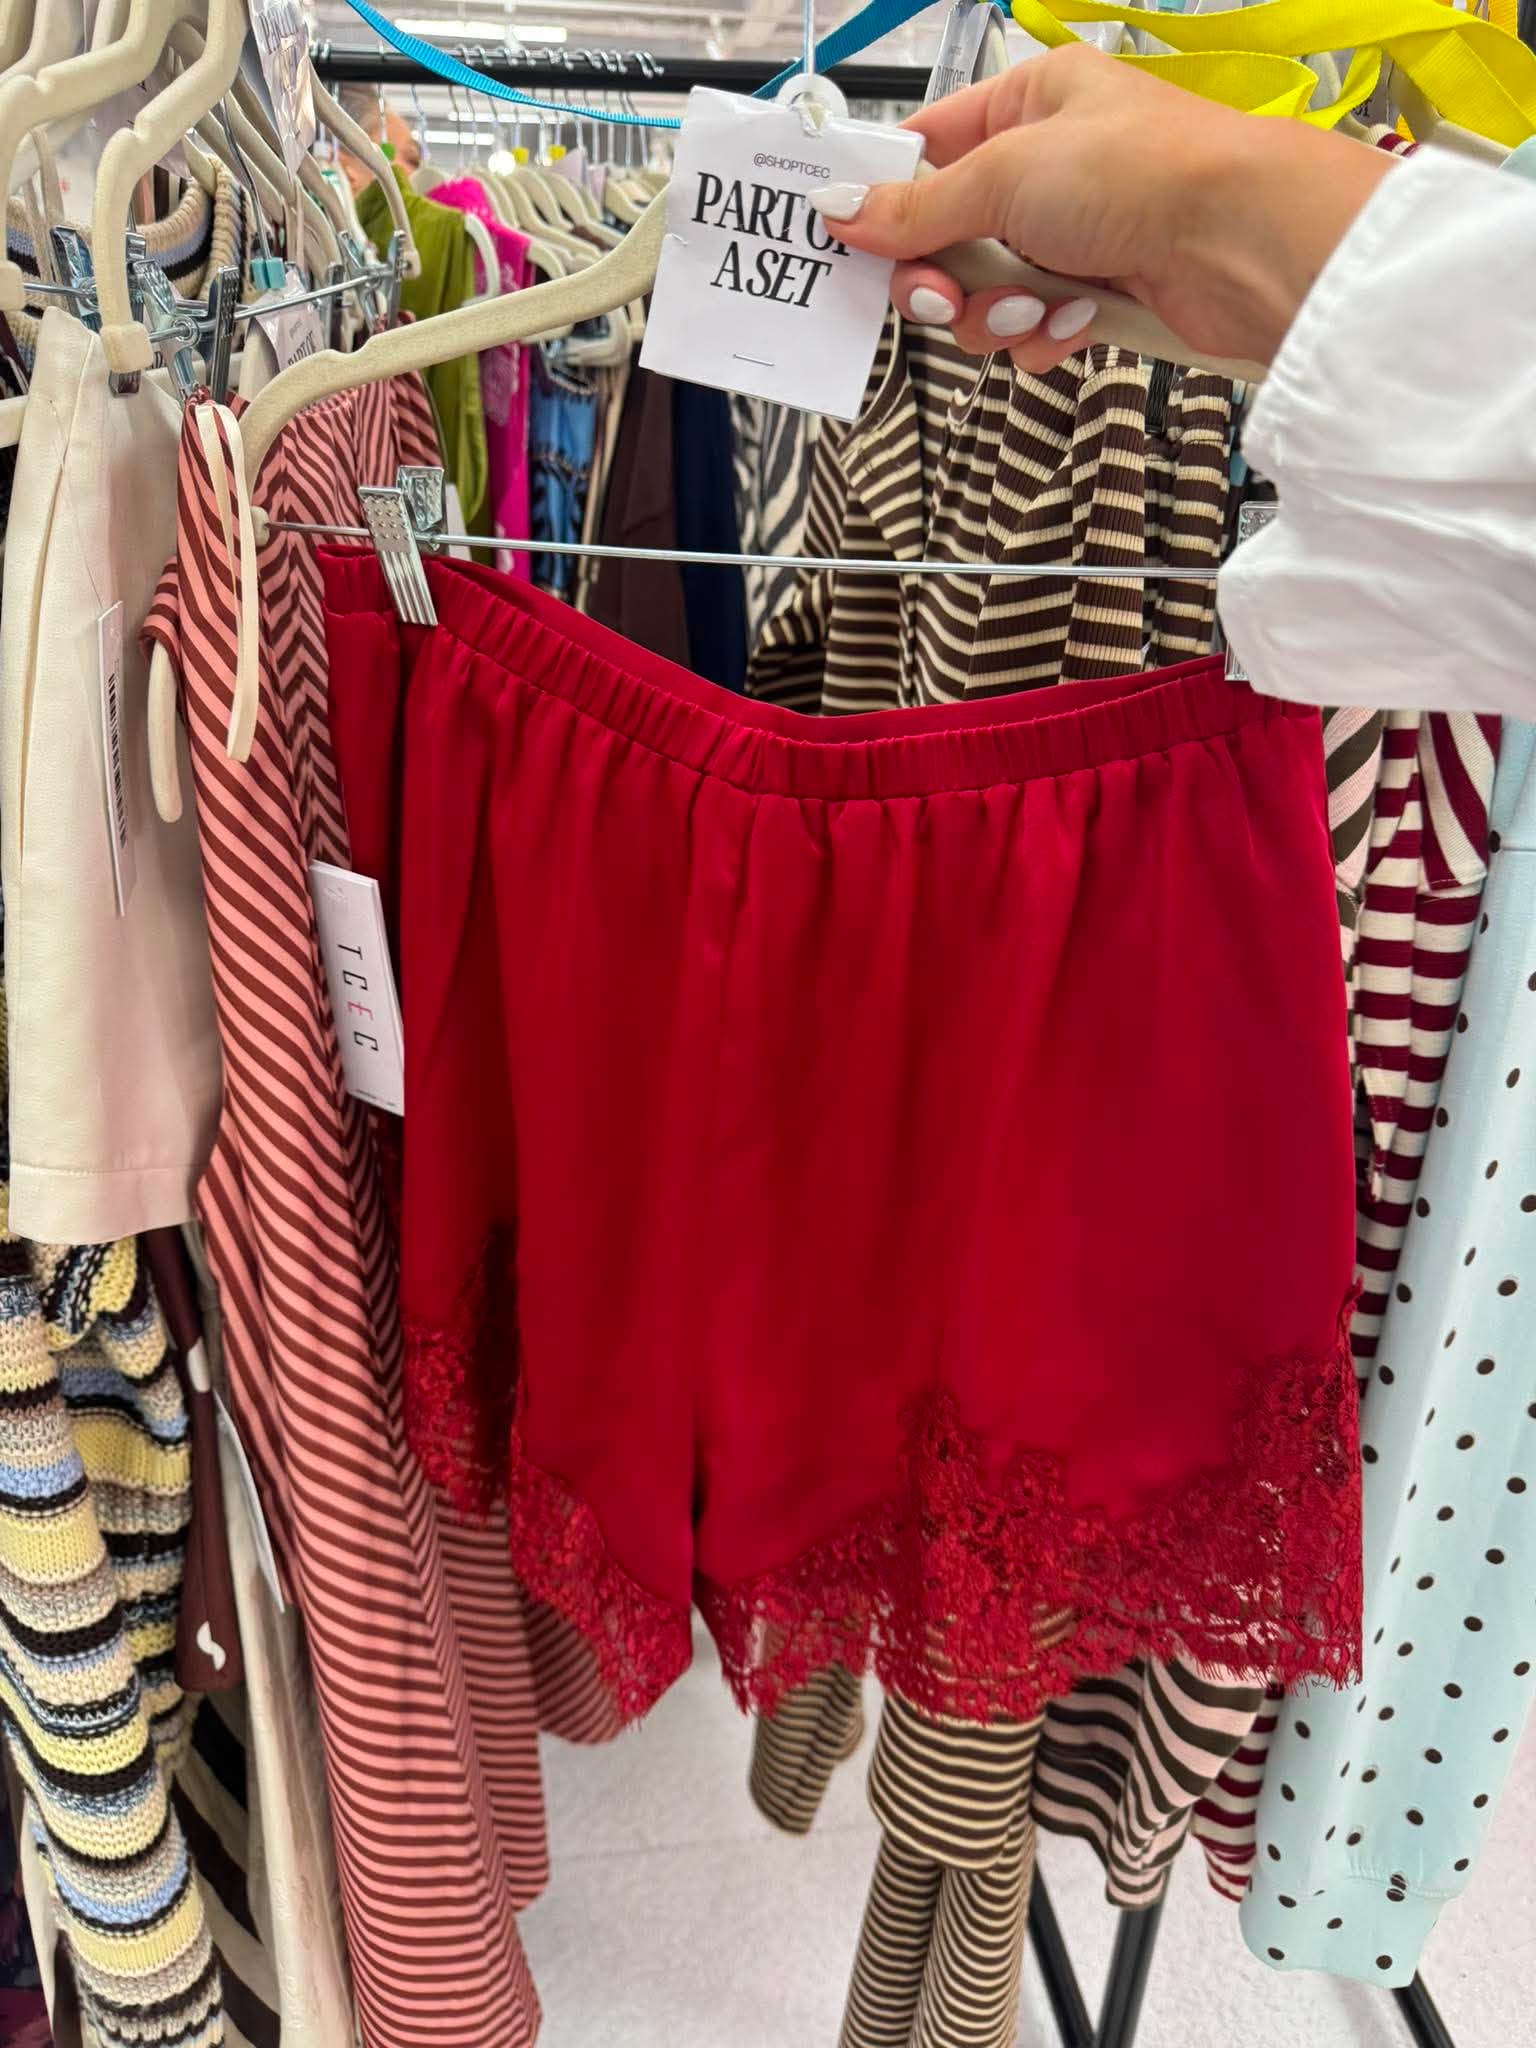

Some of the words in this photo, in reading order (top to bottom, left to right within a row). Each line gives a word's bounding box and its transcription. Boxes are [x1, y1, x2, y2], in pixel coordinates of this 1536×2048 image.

[753, 152, 831, 179] @SHOPTCEC
[691, 172, 806, 243] PART
[806, 206, 850, 257] O
[709, 240, 744, 293] A
[745, 248, 833, 308] SET
